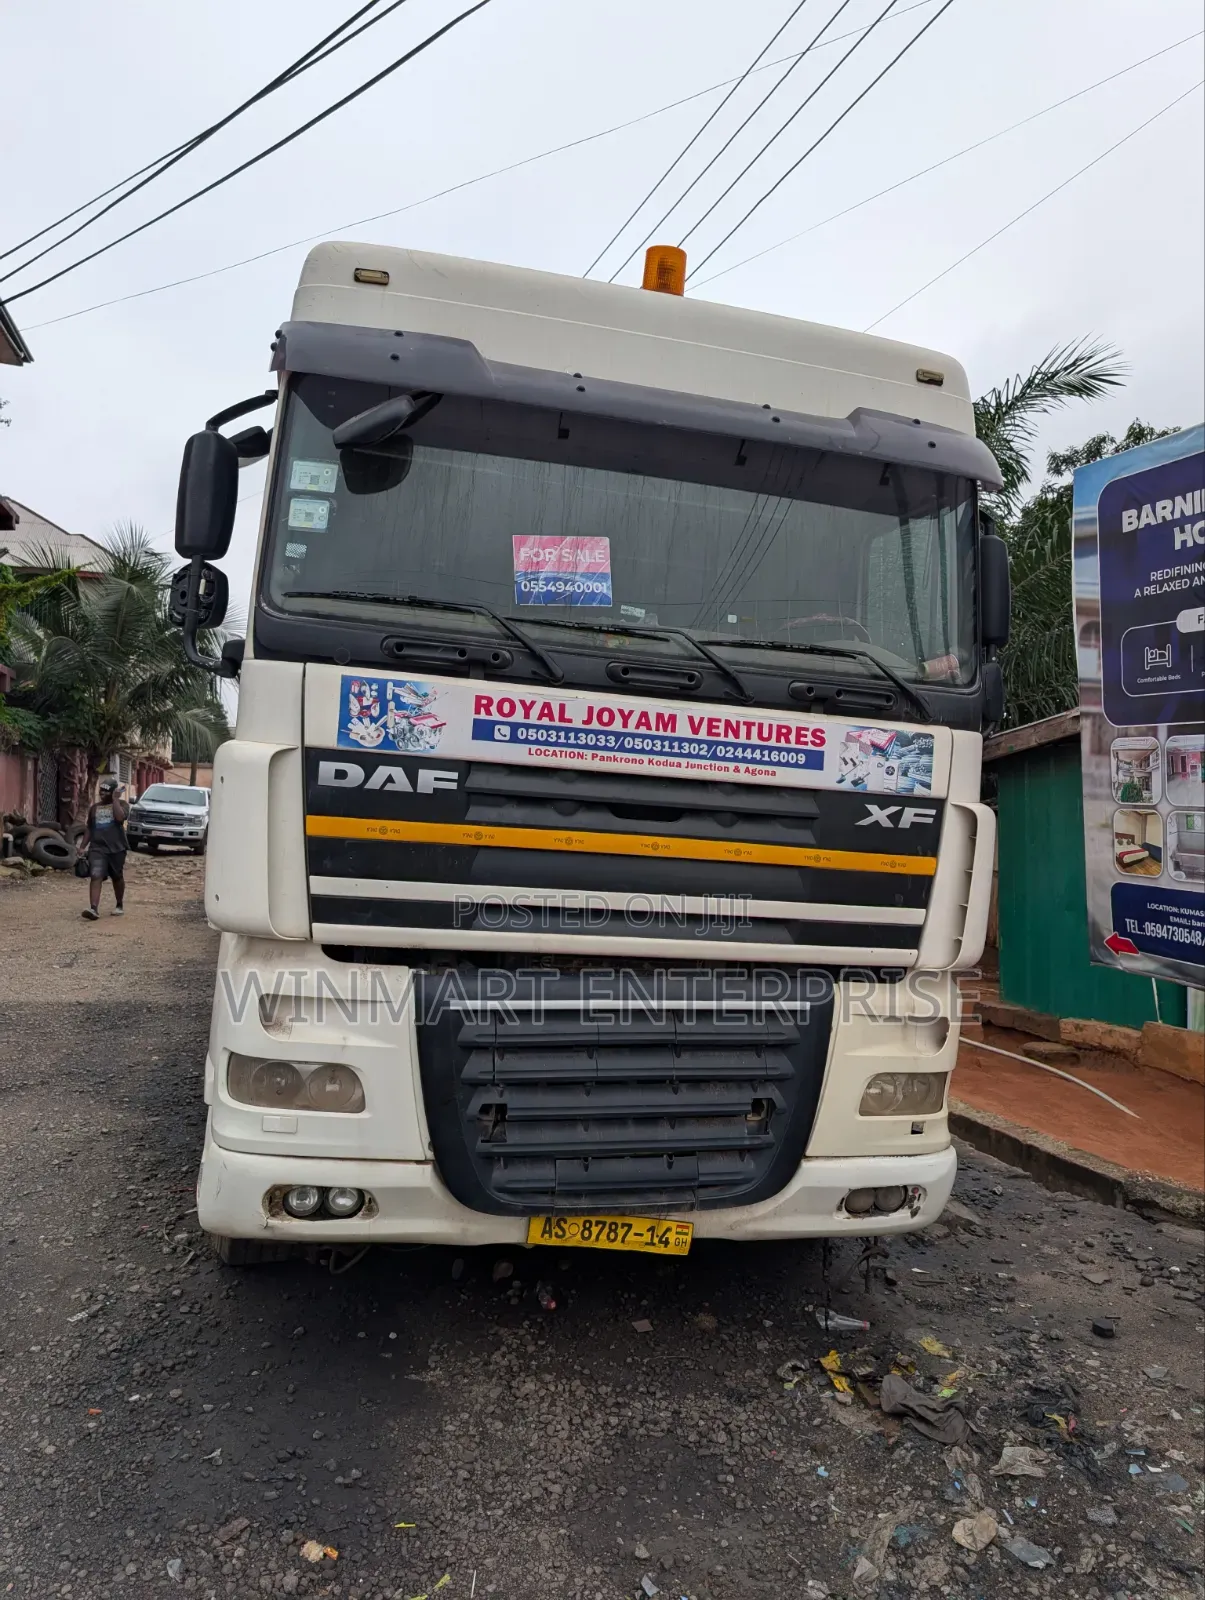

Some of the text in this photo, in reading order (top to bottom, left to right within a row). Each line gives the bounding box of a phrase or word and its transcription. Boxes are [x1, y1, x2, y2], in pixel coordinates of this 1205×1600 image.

[519, 547, 606, 563] FOR SALE
[520, 580, 607, 594] 0554940001
[1133, 588, 1142, 599] A
[1143, 578, 1190, 597] RELAXED
[1136, 675, 1167, 684] Comfortable
[474, 694, 827, 748] ROYAL JOYAM VENTURES
[528, 747, 777, 777] LOCATION: Pankrono Kodua Junction & Agona
[318, 760, 459, 794] DAF
[854, 804, 937, 828] XF
[1147, 902, 1179, 914] LOCATION:
[540, 1216, 673, 1249] AS 8787-14
[674, 1237, 688, 1248] GH
